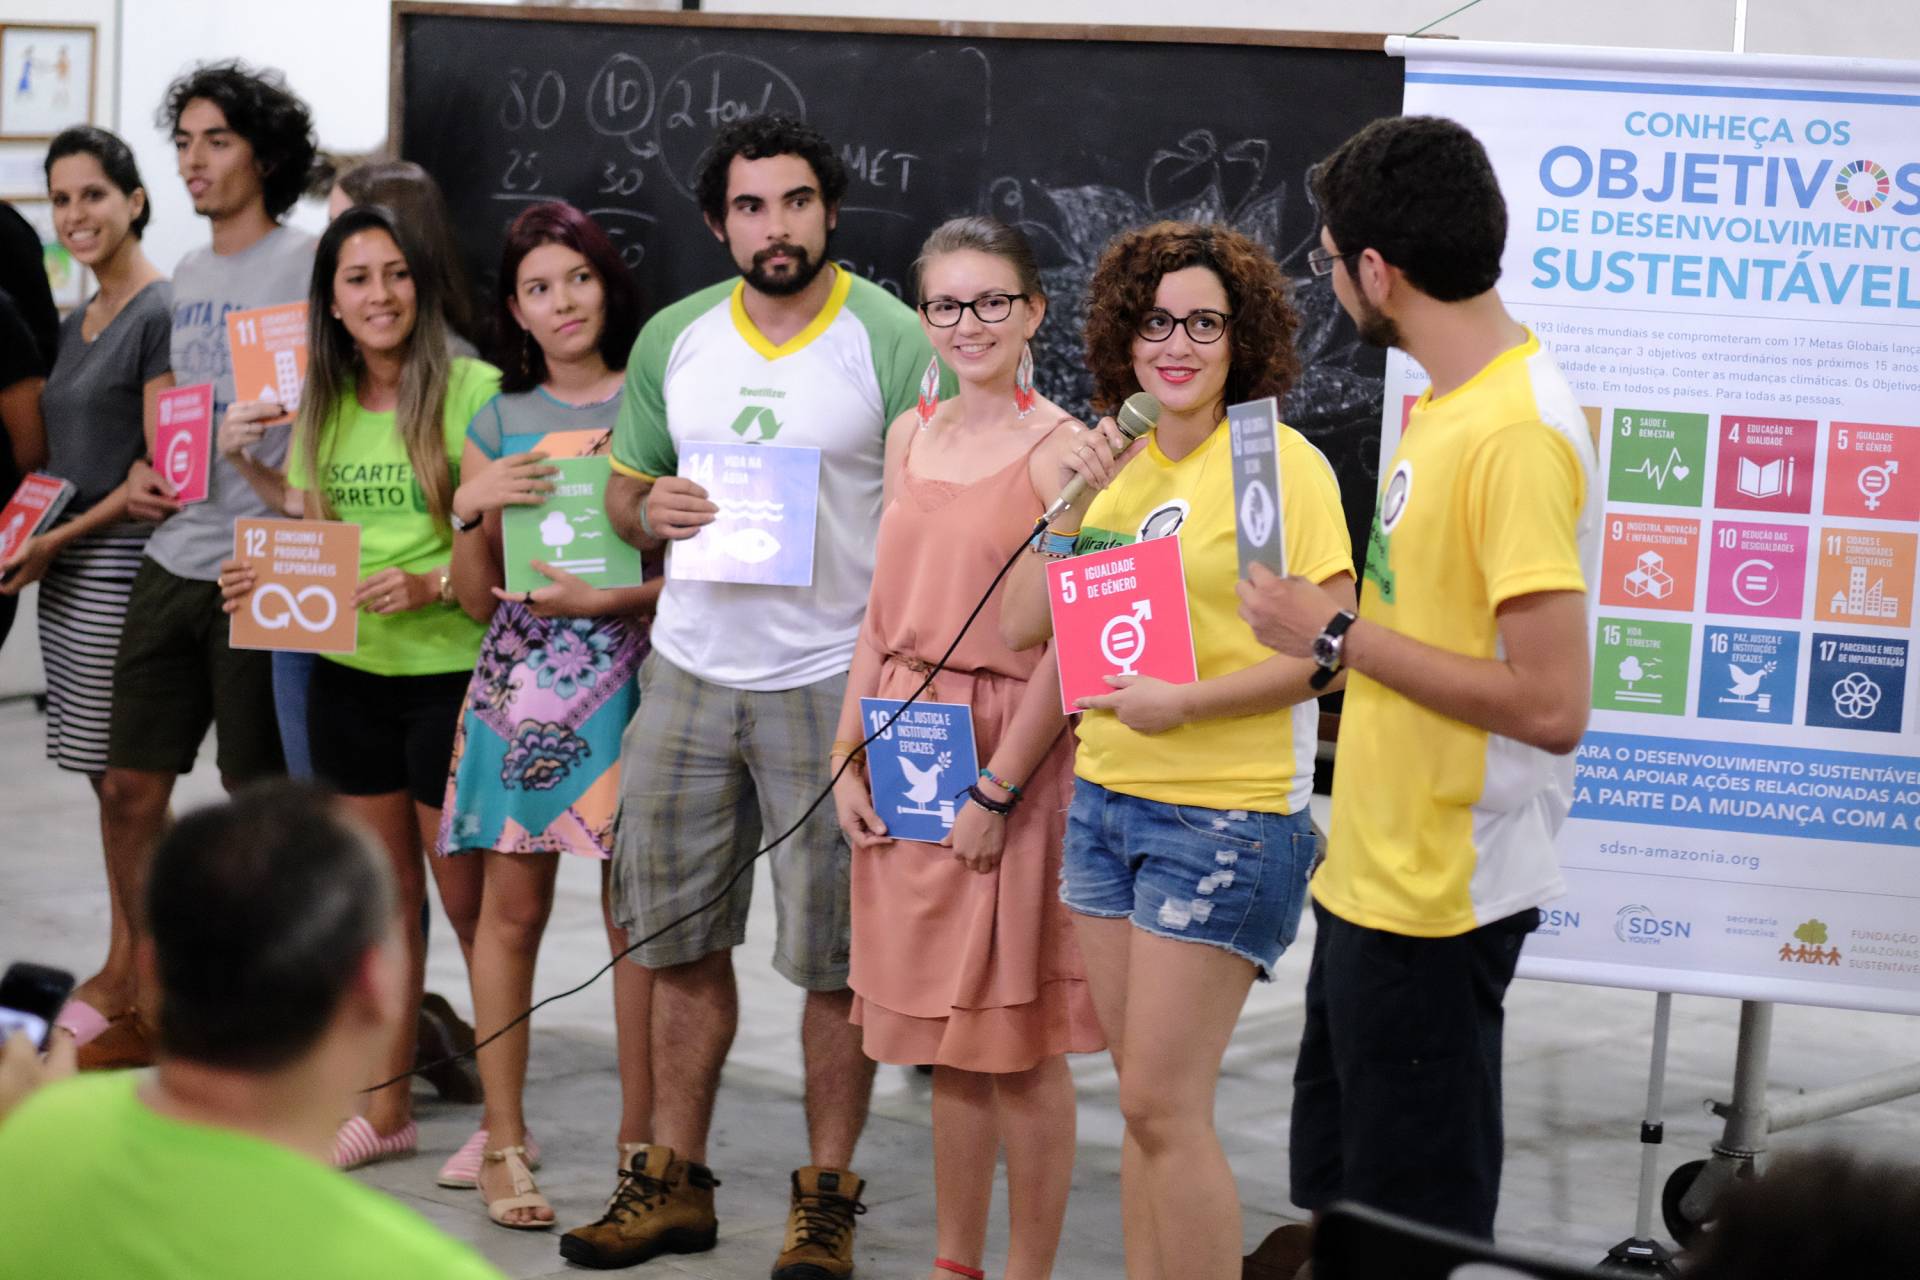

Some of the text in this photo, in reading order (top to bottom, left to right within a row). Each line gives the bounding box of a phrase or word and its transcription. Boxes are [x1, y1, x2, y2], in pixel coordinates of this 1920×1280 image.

[606, 70, 642, 118] 10
[1624, 111, 1851, 149] CONHEÇA OS
[599, 162, 644, 196] 30
[1536, 206, 1920, 253] DE DESENVOLVIMENTO
[1531, 246, 1920, 310] SUSTENTÁVEL
[236, 319, 257, 347] 11
[1535, 321, 1553, 333] 193
[1556, 323, 1594, 336] líderes
[1597, 326, 1648, 339] mundiais
[1651, 331, 1664, 340] se
[1667, 331, 1761, 346] comprometeram
[1765, 337, 1789, 347] com
[1793, 336, 1806, 347] 17
[1809, 338, 1844, 350] Metas
[1847, 339, 1889, 353] Globais
[1555, 343, 1580, 355] para
[1584, 344, 1633, 357] alcançar
[1636, 346, 1644, 356] 3
[1647, 348, 1697, 361] objetivos
[1702, 351, 1788, 366] extraordinários
[1792, 358, 1813, 367] nos
[1816, 357, 1870, 370] próximos
[1875, 360, 1888, 371] 15
[1600, 364, 1607, 372] e
[1609, 365, 1616, 373] a
[1672, 367, 1710, 378] Conter
[1712, 371, 1726, 380] as
[1728, 371, 1787, 384] mudanças
[1854, 377, 1869, 389] Os
[1602, 381, 1621, 393] Em
[1624, 383, 1655, 395] todos
[1657, 386, 1671, 396] os
[1716, 387, 1742, 399] Para
[1745, 389, 1776, 402] todas
[1778, 393, 1793, 403] as
[1621, 416, 1632, 437] 3
[1728, 423, 1741, 443] 4
[1837, 429, 1849, 450] 5
[331, 463, 408, 484] SCARTE
[688, 453, 714, 482] 14
[243, 527, 267, 558] 12
[1612, 521, 1623, 541] 9
[1718, 528, 1737, 549] 10
[1826, 535, 1841, 556] 11
[1084, 557, 1137, 581] IGUALDADE
[1060, 570, 1077, 604] 5
[1087, 575, 1138, 599] DE GÊNERO
[1603, 625, 1621, 646] 15
[1710, 633, 1729, 654] 16
[1819, 641, 1838, 662] 17
[869, 709, 893, 741] 16
[1576, 744, 1612, 760] ARA
[1615, 747, 1630, 762] O
[1634, 749, 1804, 776] DESENVOLVIMENTO
[1575, 764, 1619, 781] PARA
[1623, 768, 1688, 786] APOIAR
[1692, 773, 1750, 793] AÇÕES
[1754, 779, 1890, 804] RELACIONADAS
[1599, 788, 1664, 810] PARTE
[1670, 795, 1703, 813] DA
[1708, 798, 1825, 826] MUDANÇA
[1832, 808, 1885, 828] COM
[1891, 812, 1908, 830] A
[1599, 840, 1760, 870] sdsn-amazonia.org
[1538, 908, 1581, 929] DSN
[1628, 916, 1691, 938] SDSN
[1627, 935, 1660, 945] YOUTH
